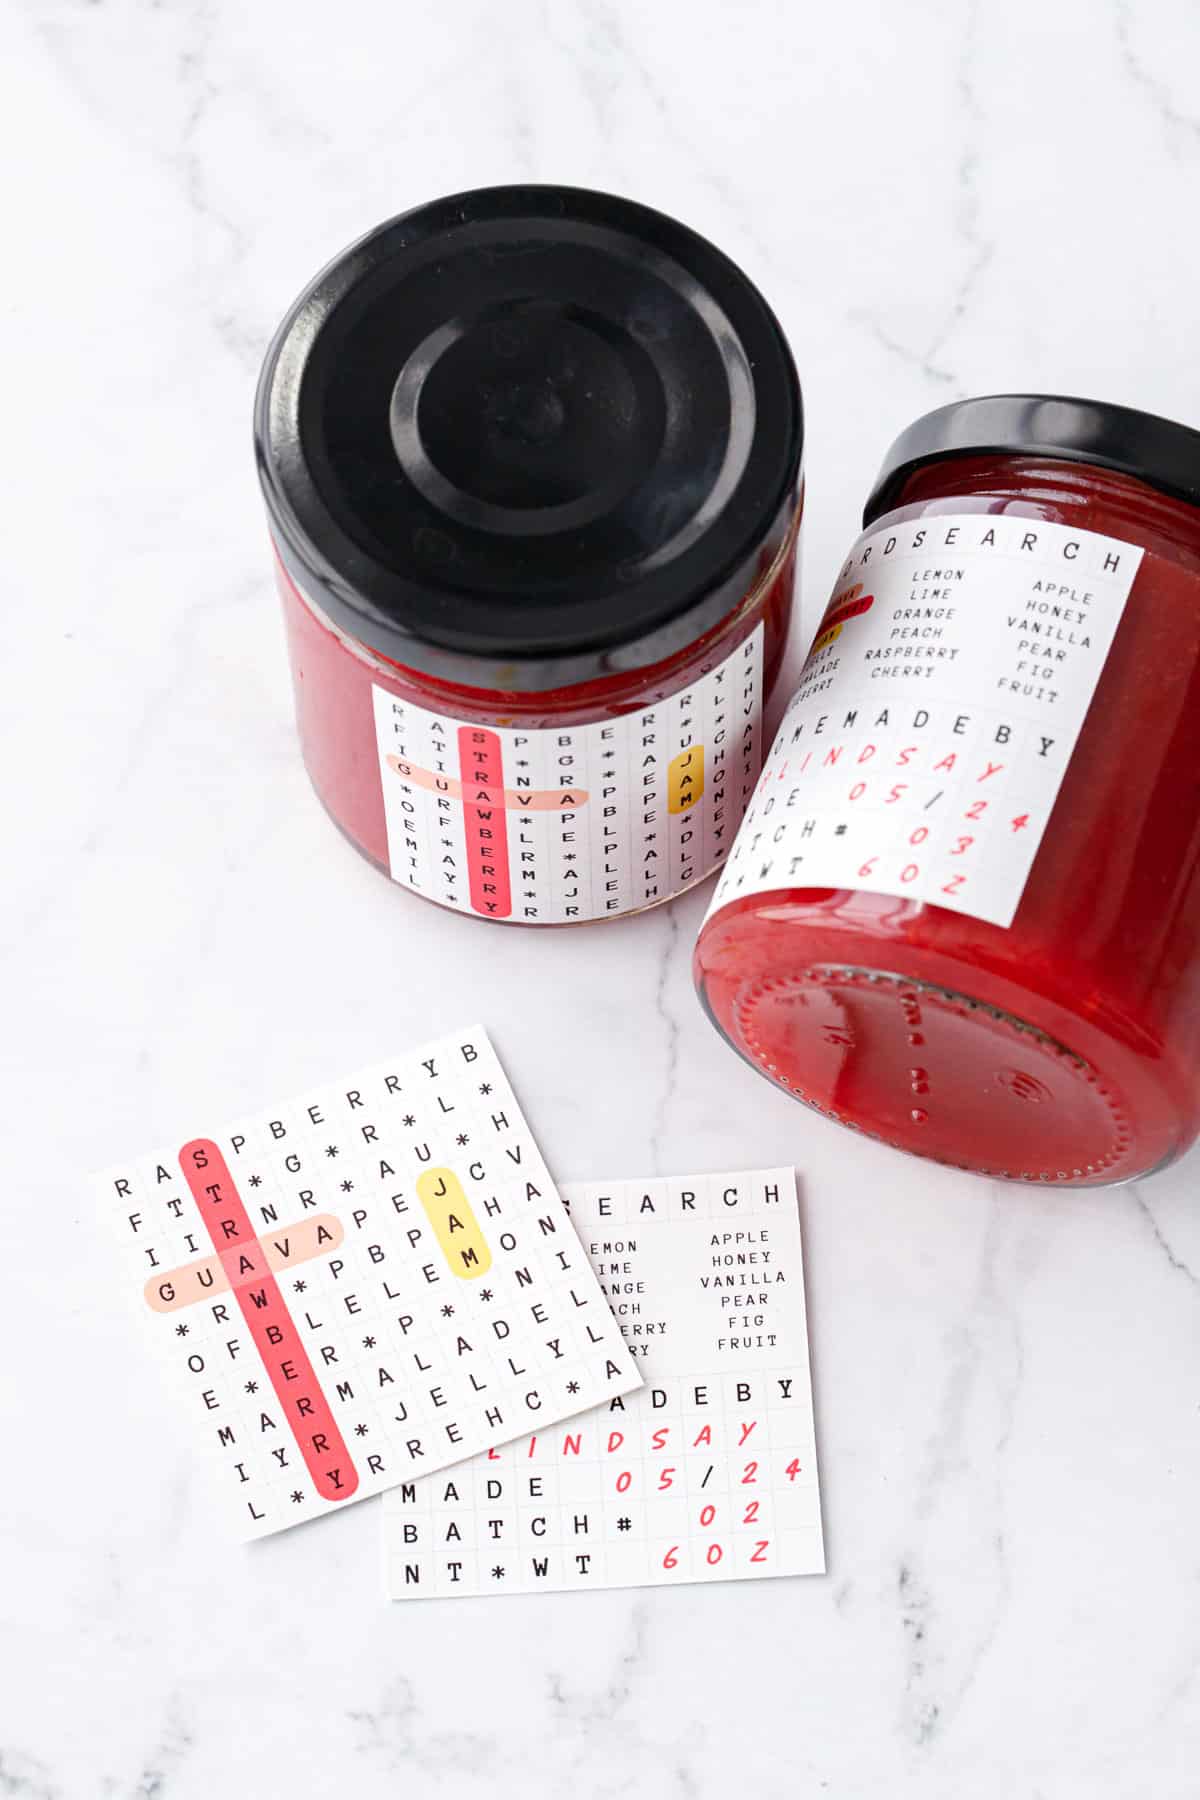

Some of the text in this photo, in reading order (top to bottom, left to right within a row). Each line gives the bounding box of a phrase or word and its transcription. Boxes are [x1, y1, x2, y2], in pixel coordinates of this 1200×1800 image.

[912, 569, 965, 582] LEMON
[910, 588, 952, 600] LIME
[1033, 580, 1094, 606] APPLE
[893, 608, 957, 620] ORANGE
[1026, 600, 1087, 625] HONEY
[890, 627, 944, 639] PEACH
[1007, 616, 1092, 649] VANILLA
[864, 648, 960, 662] RASPBERRY
[1018, 639, 1068, 663] PEAR
[871, 666, 935, 679] CHERRY
[1016, 660, 1055, 680] FIG
[997, 678, 1059, 704] FRUIT
[710, 1230, 770, 1246] APPLE
[590, 1240, 637, 1255] EMON
[712, 1251, 771, 1267] HONEY
[598, 1261, 633, 1275] IME
[700, 1271, 786, 1289] VANILLA
[721, 1292, 769, 1308] PEAR
[620, 1322, 667, 1337] ERRY
[728, 1314, 765, 1329] FIG
[718, 1334, 778, 1351] FRUIT
